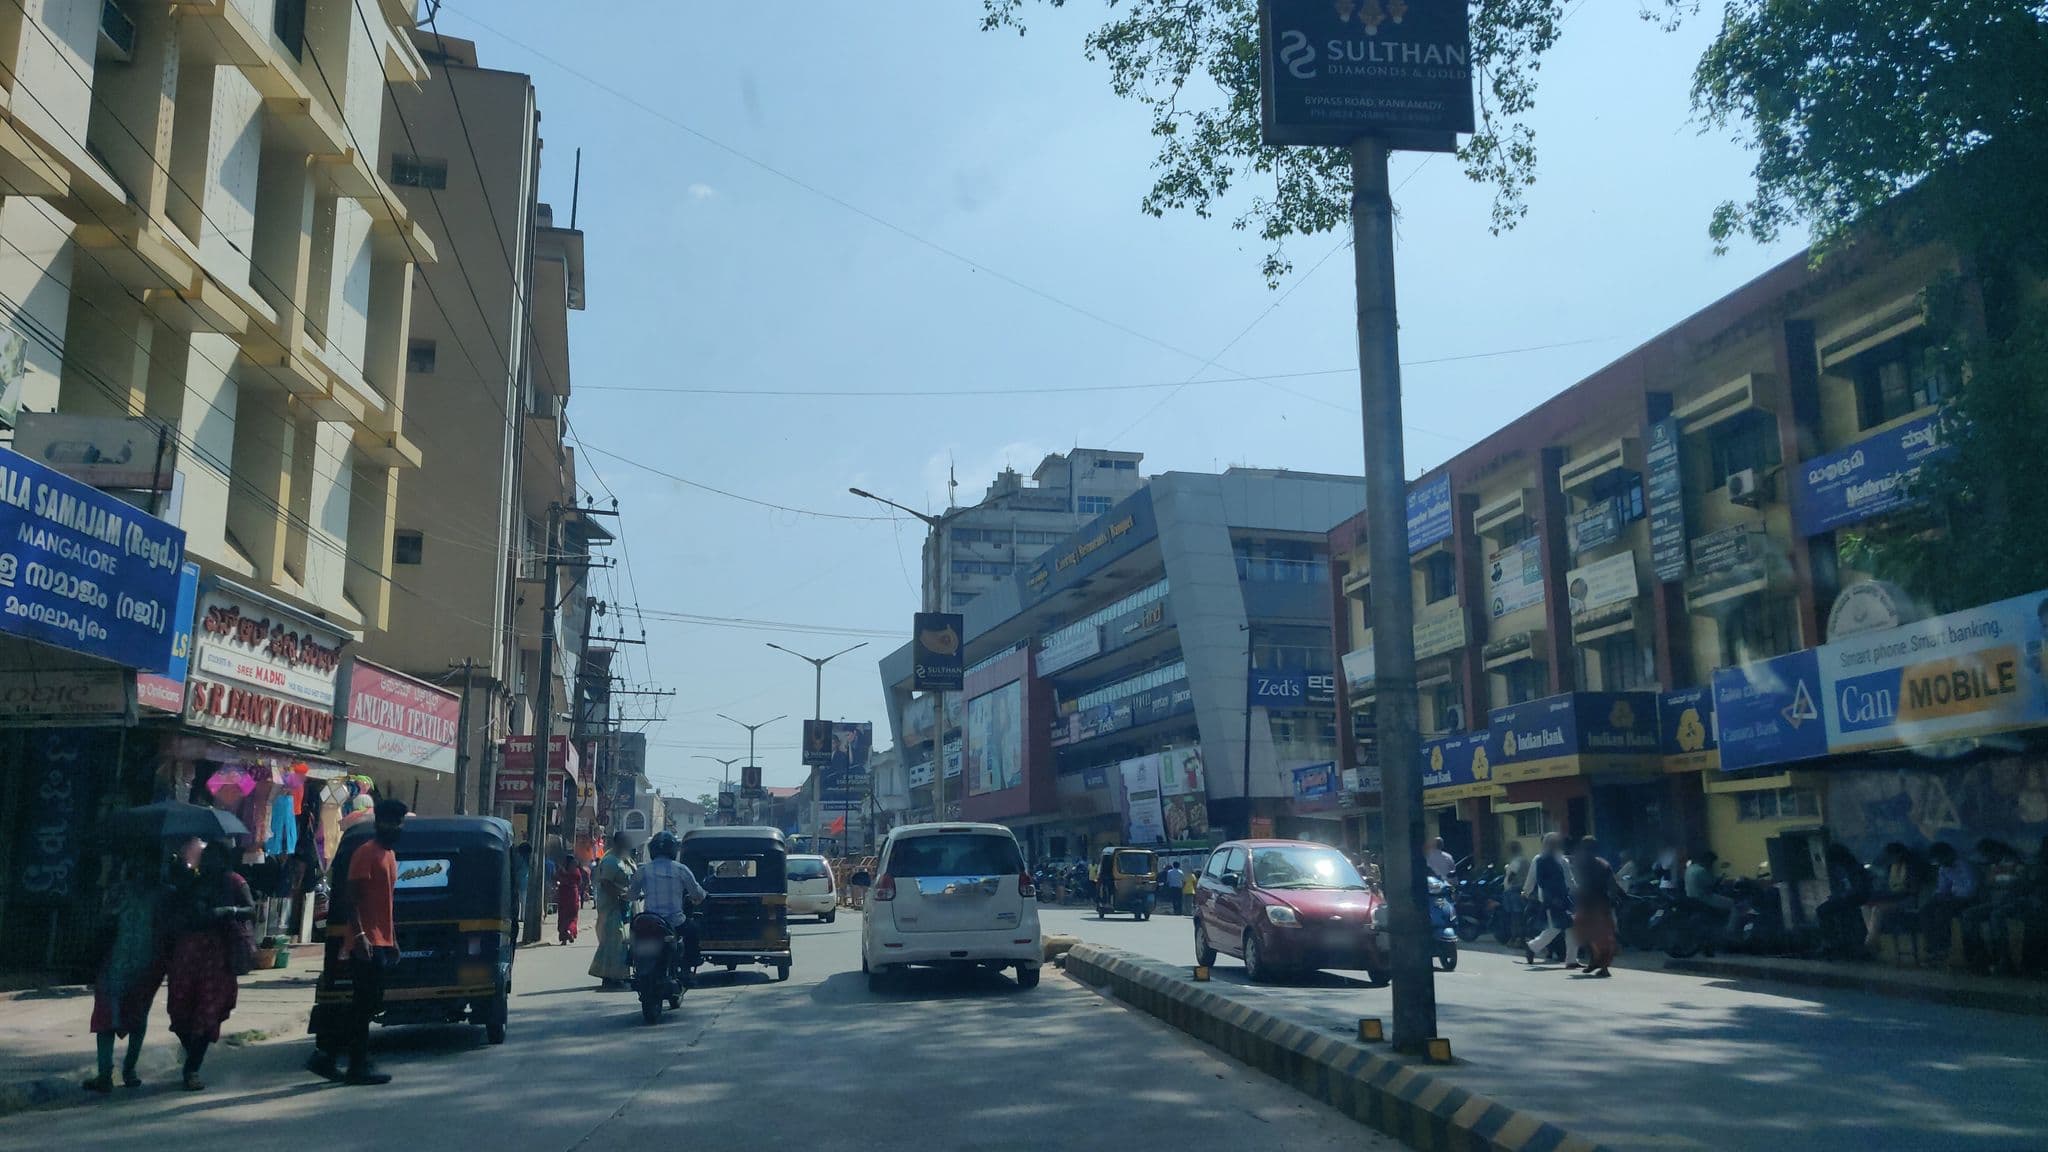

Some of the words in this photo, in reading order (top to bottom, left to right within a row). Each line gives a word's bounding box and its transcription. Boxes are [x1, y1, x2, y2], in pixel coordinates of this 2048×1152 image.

[1327, 39, 1466, 66] SULTHAN
[1327, 64, 1408, 78] DIAMONDS
[1427, 68, 1467, 80] GOLD
[1305, 95, 1343, 106] BYPASS
[18, 521, 119, 577] MANGALORE
[35, 483, 123, 548] SAMAJAM
[124, 520, 179, 576] (Regd.)
[25, 561, 109, 610] സമാജം
[5, 595, 108, 642] മംഗലാപുരം
[1839, 646, 1872, 668] Smart
[1948, 618, 2003, 645] banking.
[236, 663, 253, 678] SREE
[255, 665, 287, 687] MADHU
[1257, 678, 1300, 696] Zed's
[1841, 686, 1893, 723] Can
[1908, 661, 2017, 709] MOBILE
[192, 680, 208, 712] S
[210, 683, 225, 716] R
[226, 687, 281, 729] FANCY
[280, 701, 333, 742] CENTER
[352, 692, 405, 732] ANUPAM
[407, 708, 456, 745] TEXTILES
[1517, 731, 1542, 751] Indian
[1543, 726, 1565, 748] Bank
[497, 779, 529, 791] STEP
